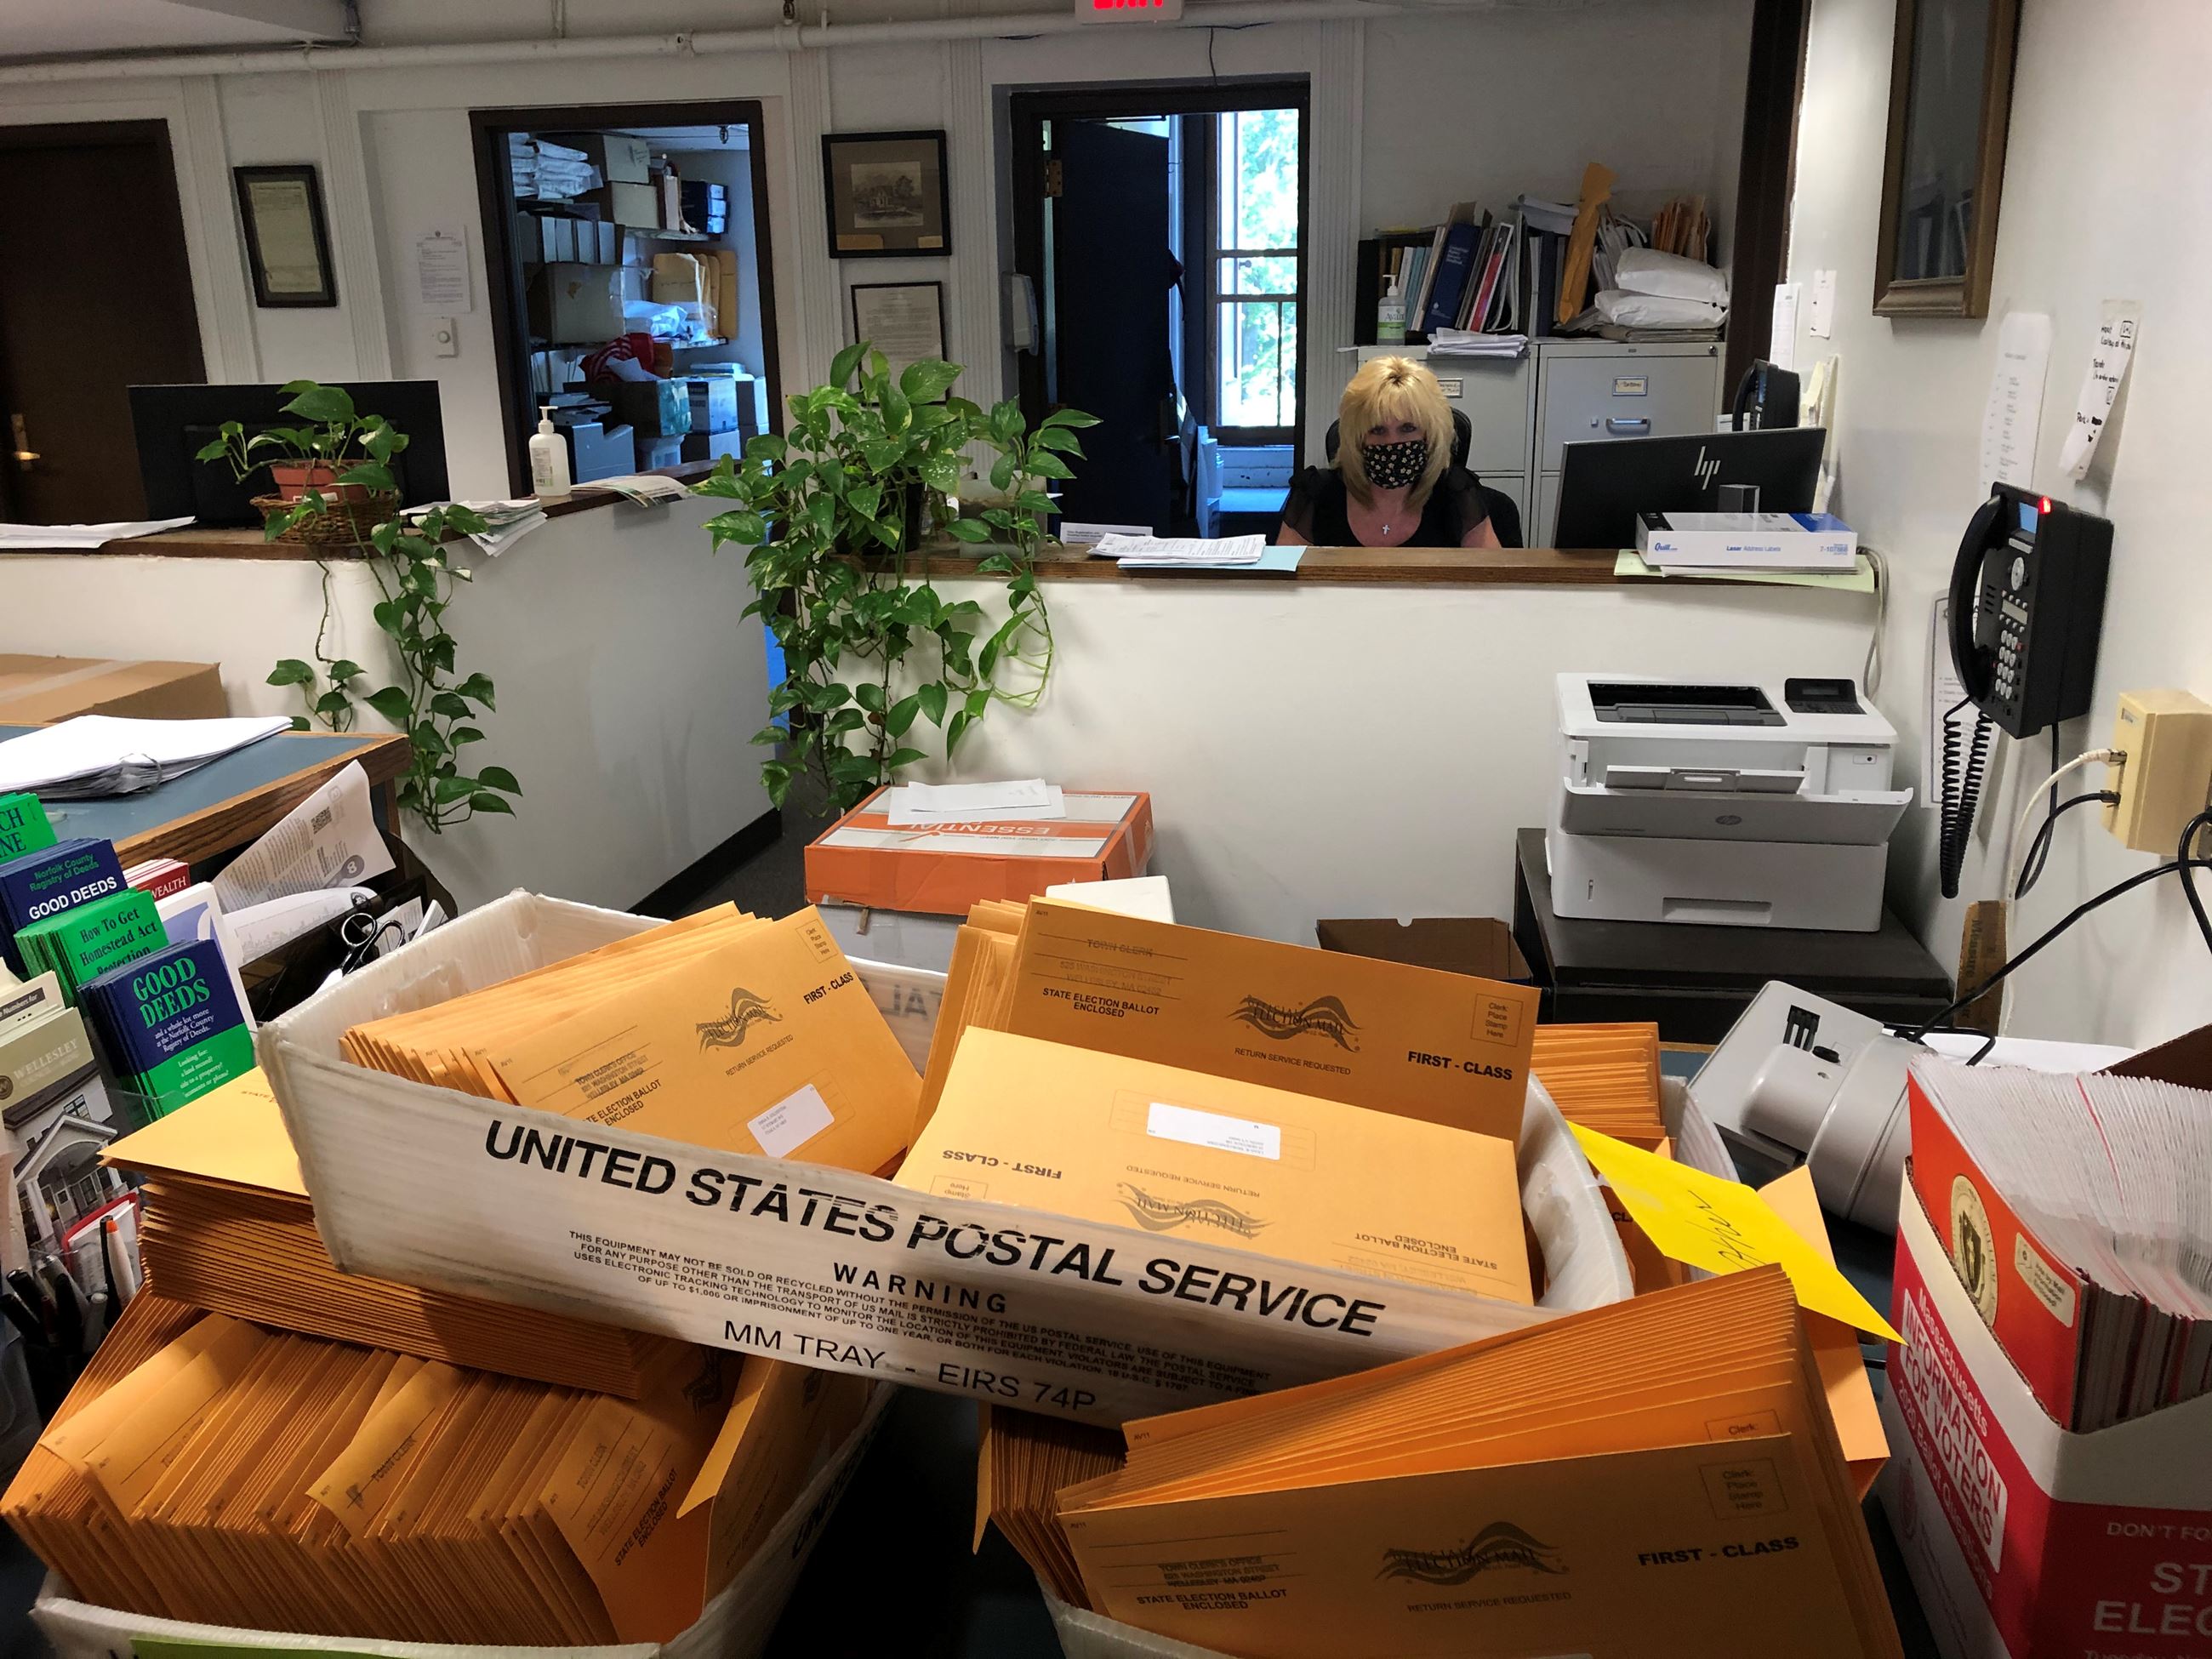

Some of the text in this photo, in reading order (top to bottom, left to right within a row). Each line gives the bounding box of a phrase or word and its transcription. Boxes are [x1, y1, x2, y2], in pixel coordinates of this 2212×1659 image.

[29, 861, 100, 892] Registry of Deeds
[34, 853, 94, 880] Norfolk County
[29, 876, 117, 920] GOOD DEEDS
[80, 907, 140, 944] How To Get
[79, 920, 158, 967] Homestead Act
[1119, 944, 1154, 957] CLERK
[133, 957, 196, 1001] GOOD
[803, 972, 854, 1004] FIRST CLASS
[140, 978, 211, 1029] DEEDS
[1043, 987, 1160, 1015] STATE ELECTION BALLOT
[1074, 1002, 1125, 1018] ENCLOSED
[1487, 1012, 1508, 1021] Place
[168, 1019, 182, 1034] whole
[192, 1009, 209, 1021] more
[169, 1025, 191, 1042] Norfolk
[191, 1015, 214, 1031] County
[1485, 1021, 1508, 1031] Stamp
[1487, 1029, 1504, 1038] Here
[14, 1038, 77, 1080] WELLESLEY
[163, 1037, 183, 1052] Registry
[725, 1035, 794, 1077] RETURN SERVICE REQUESTED
[1234, 1047, 1351, 1075] RETURN SERVICE REQUESTED
[1407, 1050, 1513, 1080] FIRST CLASS
[597, 1095, 633, 1120] ELECTION
[633, 1079, 662, 1099] BALLOT
[605, 1100, 644, 1126] ENCLOSED
[943, 1149, 1062, 1179] FIRST CLASS
[1126, 1165, 1260, 1198] RETURN SERVICE REQUESTED
[485, 1120, 676, 1195] UNITED
[685, 1167, 899, 1243] STATES
[906, 1215, 1123, 1287] POSTAL
[1138, 1259, 1387, 1337] SERVICE
[1394, 1235, 1457, 1254] ENCLOSED
[1354, 1233, 1497, 1269] STATE ELECTION BALLOT
[834, 1263, 1007, 1314] WARNING
[568, 1231, 1270, 1380] THIS EQUIPMENT MAY NOT BE SOLD OR RECYCLED WITHOUT THE PERMISSION OF THE US POSTAL USE EQUIPMENT
[573, 1252, 601, 1263] USES
[605, 1258, 670, 1279] ELECTRONIC
[674, 1274, 727, 1291] TRACKING
[732, 1286, 804, 1308] TECHNOLOGY
[824, 1305, 872, 1320] MONITOR
[876, 1316, 896, 1325] THE
[900, 1320, 956, 1337] LOCATION
[974, 1335, 996, 1345] THIS
[1069, 1351, 1127, 1371] VIOLATORS
[581, 1244, 602, 1254] FOR
[605, 1250, 624, 1259] ANY
[629, 1255, 678, 1270] PURPOSE
[681, 1266, 717, 1280] OTHER
[721, 1274, 749, 1286] THAN
[753, 1281, 772, 1291] THE
[777, 1285, 841, 1306] TRANSPORT
[844, 1300, 858, 1308] OF
[861, 1303, 875, 1313] US
[879, 1307, 904, 1318] MAIL
[920, 1314, 969, 1331] STRICTLY
[973, 1324, 1038, 1344] PROHIBITED
[1058, 1339, 1108, 1357] FEDERAL
[1164, 1361, 1204, 1377] POSTAL
[1208, 1371, 1255, 1387] SERVICE
[638, 1275, 651, 1284] OF
[654, 1279, 669, 1287] UP
[688, 1286, 720, 1298] $1,000
[723, 1293, 738, 1302] OR
[741, 1297, 821, 1319] IMPRISONMENT
[876, 1325, 898, 1334] ONE
[937, 1336, 952, 1344] OR
[955, 1339, 984, 1351] BOTH
[989, 1346, 1008, 1355] FOR
[1012, 1348, 1043, 1363] EACH
[725, 1320, 1096, 1411] MM TRAY EIRS 74P
[1919, 1286, 1989, 1438] Massachusetts
[1905, 1298, 2002, 1516] INFORMATION
[1905, 1344, 1993, 1546] FOR VOTERS
[1898, 1378, 1993, 1601] 2020 Ballot Questions
[614, 1467, 679, 1566] STATE ELECTION BALLOT
[638, 1501, 669, 1548] ENCLOSED
[2107, 1521, 2175, 1539] DON'T
[1637, 1536, 1799, 1566] FIRST CLASS
[1137, 1589, 1287, 1605] STATE ELECTION BALLOT
[1182, 1601, 1249, 1610] ENCLOSED
[1407, 1592, 1572, 1613] RETURN SERVICE REQUESTED
